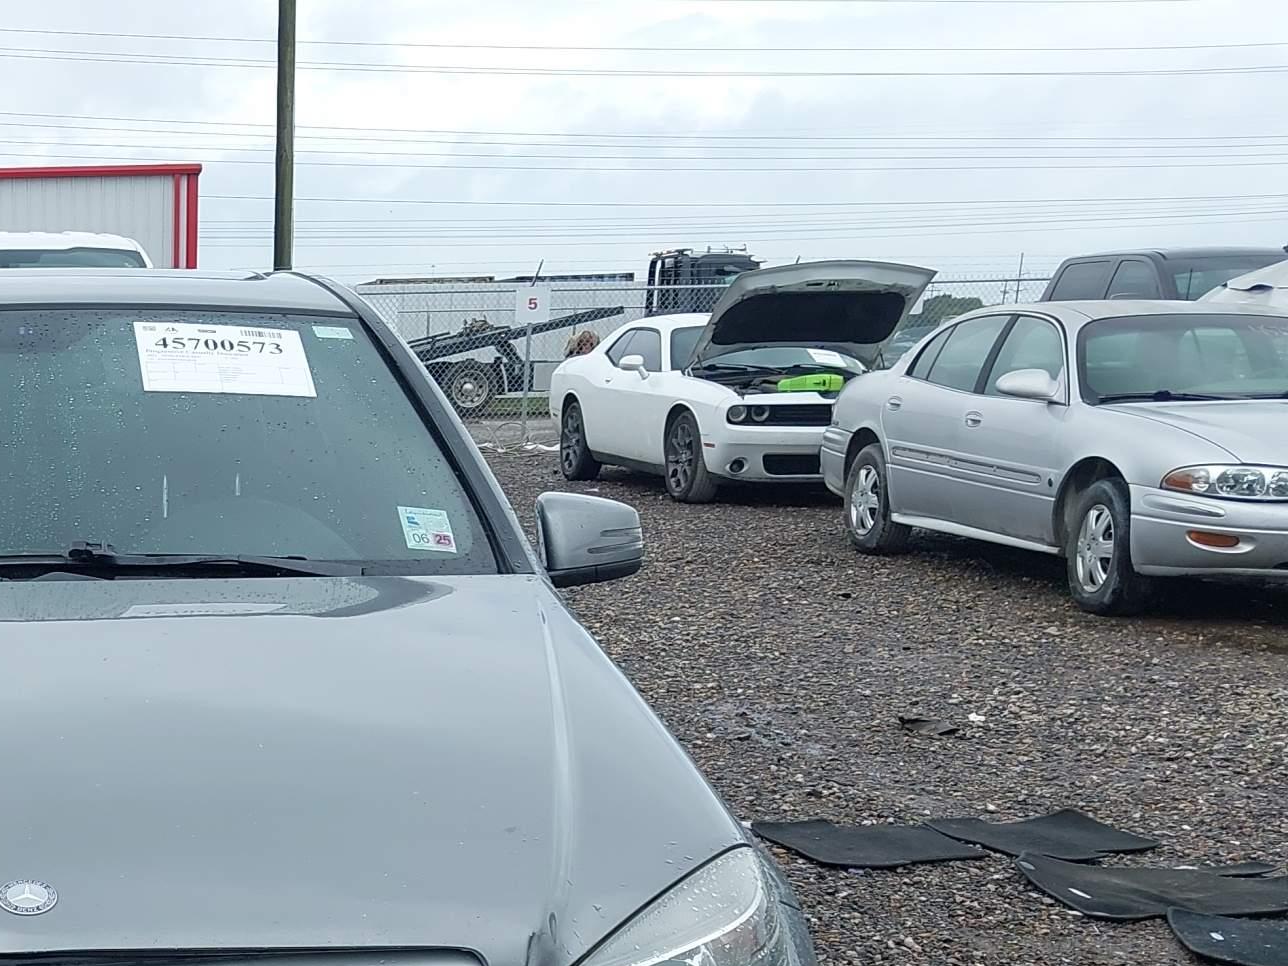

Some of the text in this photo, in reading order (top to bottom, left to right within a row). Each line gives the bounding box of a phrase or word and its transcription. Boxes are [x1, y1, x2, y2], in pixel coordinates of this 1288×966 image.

[527, 297, 538, 311] 5
[154, 336, 284, 355] 45700573
[412, 533, 452, 546] 06 25
